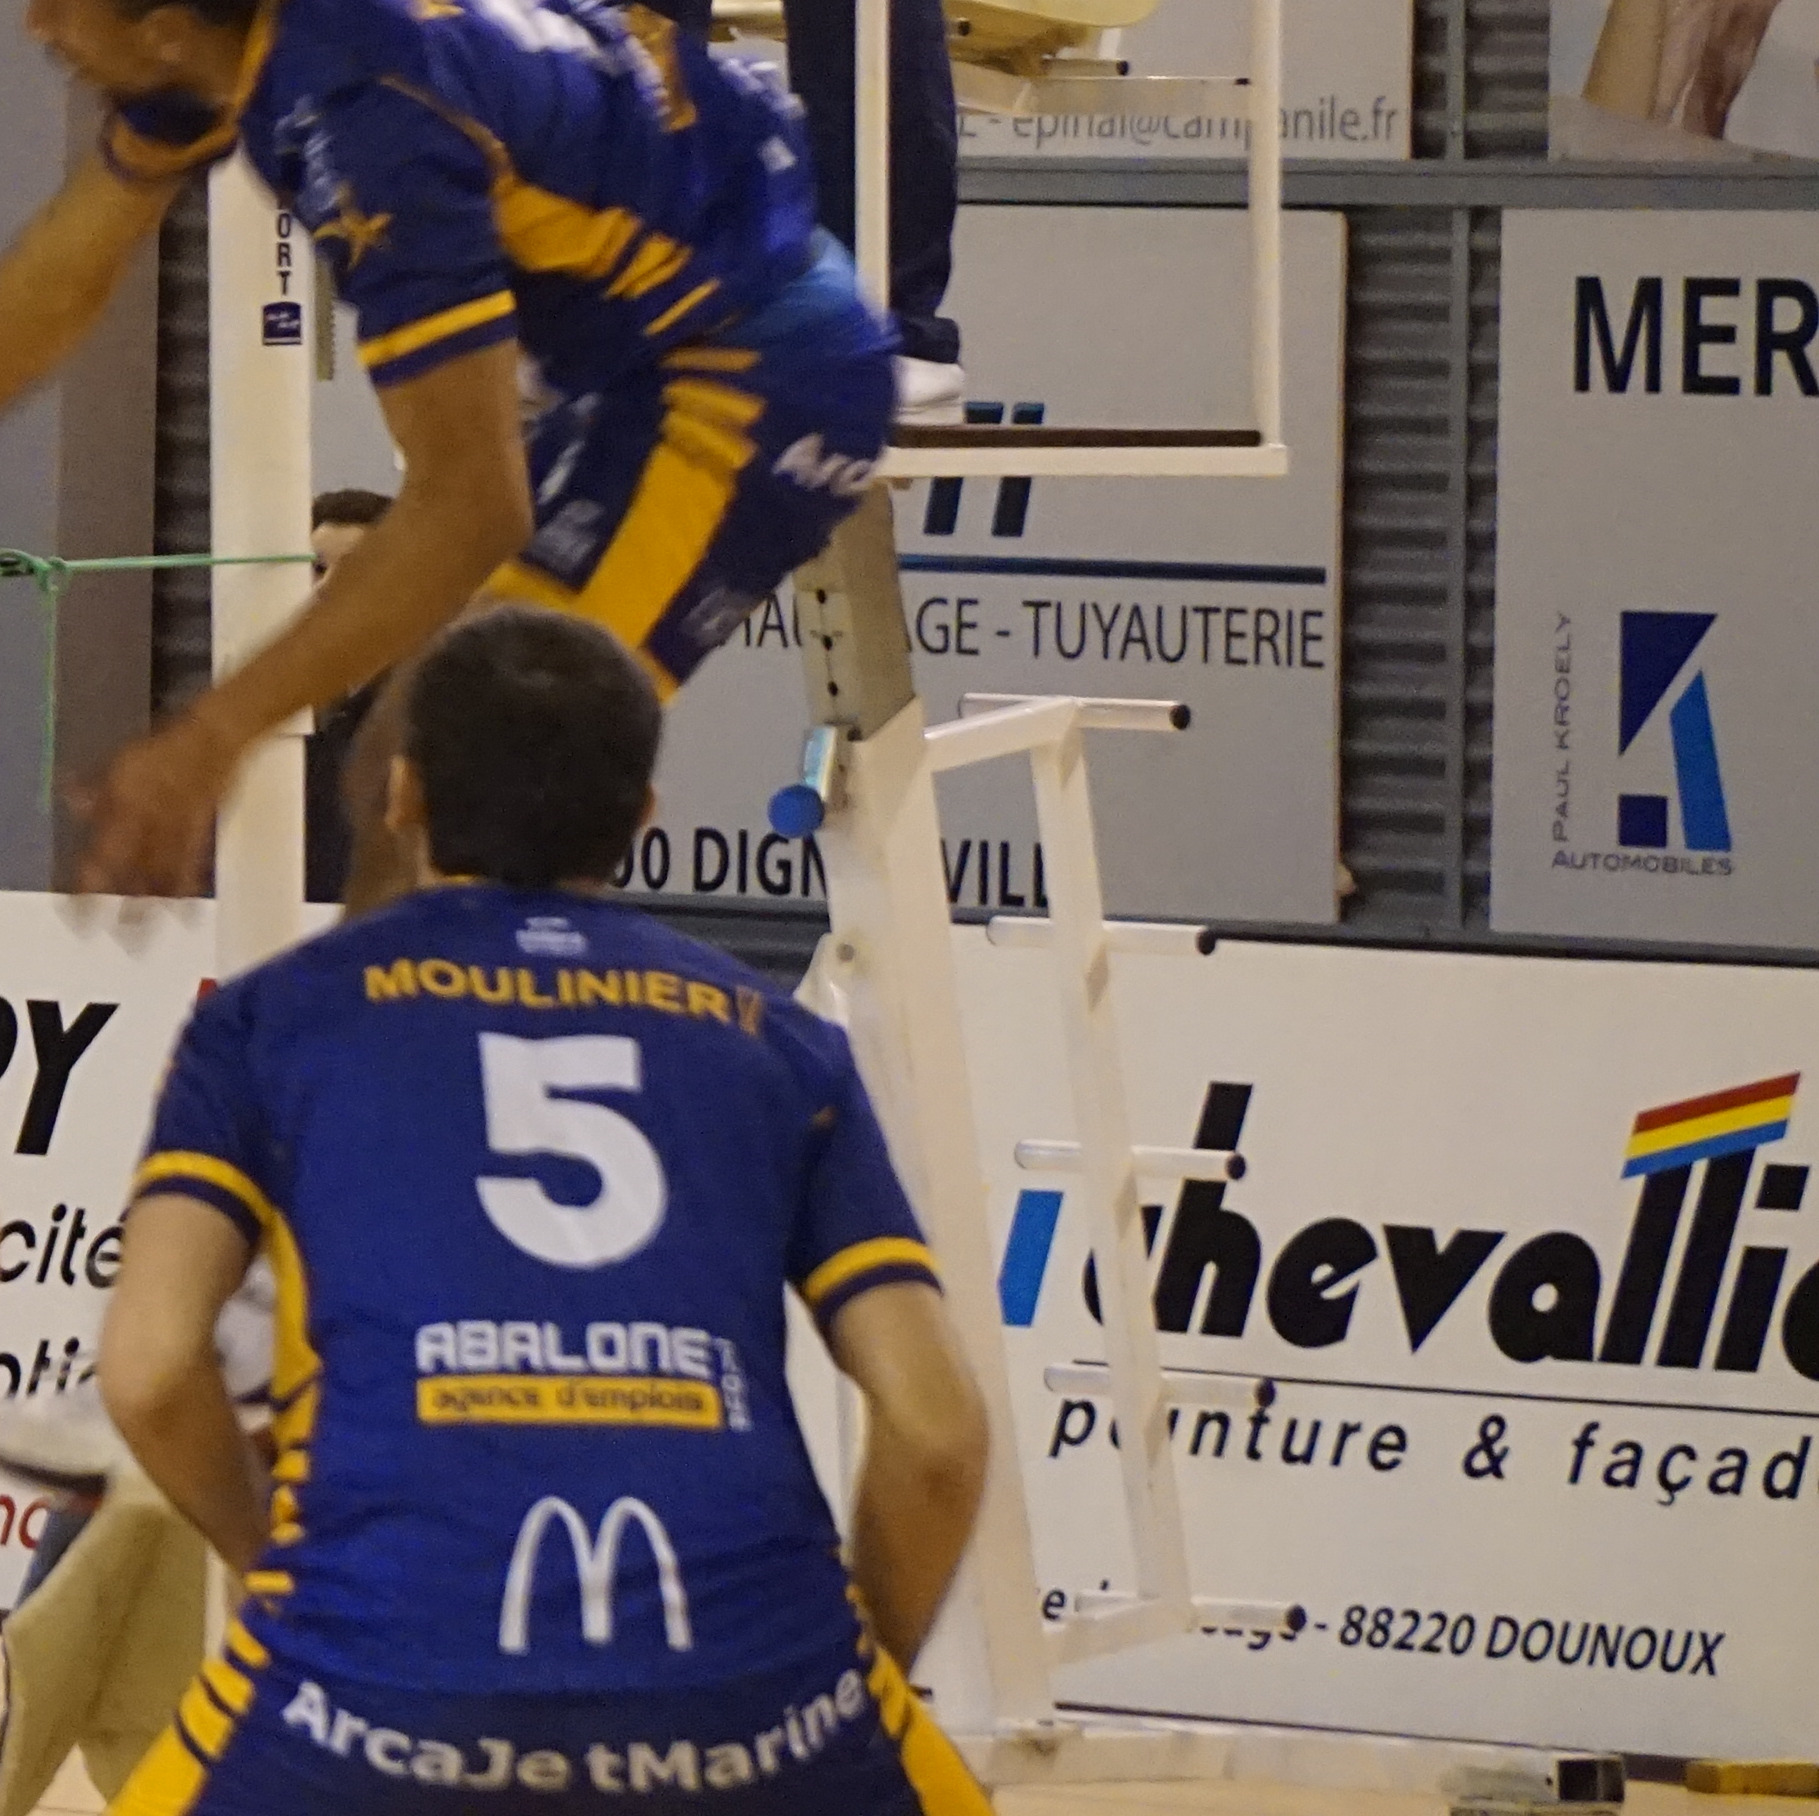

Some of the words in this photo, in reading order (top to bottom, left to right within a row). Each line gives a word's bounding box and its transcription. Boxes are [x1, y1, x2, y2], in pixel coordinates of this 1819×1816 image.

[1022, 600, 1327, 669] TUYAUTERIE
[365, 957, 732, 1026] MOULINIER
[475, 1031, 669, 1270] 5
[416, 1319, 713, 1380] ABALONE
[1047, 1392, 1408, 1474] pnture
[1462, 1413, 1511, 1482] &
[1566, 1420, 1819, 1506] façad
[1338, 1604, 1476, 1658] 88220
[1485, 1612, 1726, 1678] DOUNOUX
